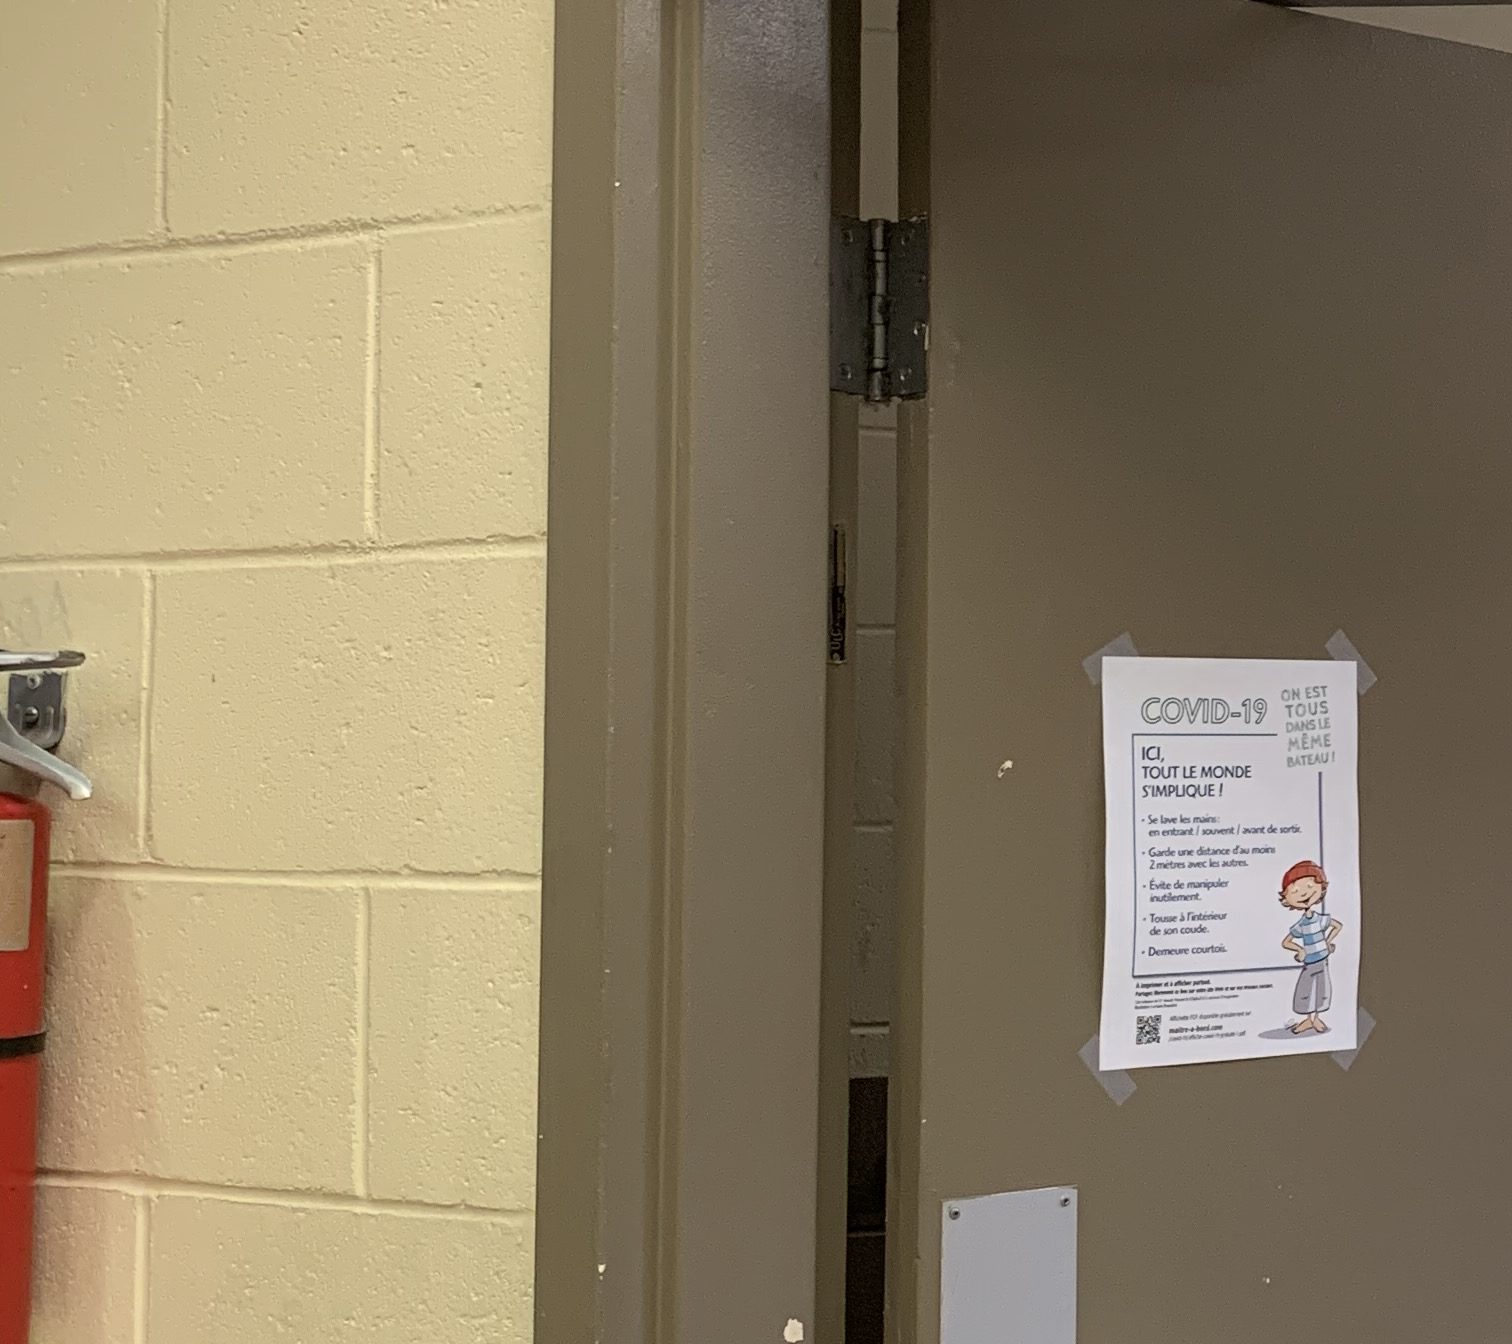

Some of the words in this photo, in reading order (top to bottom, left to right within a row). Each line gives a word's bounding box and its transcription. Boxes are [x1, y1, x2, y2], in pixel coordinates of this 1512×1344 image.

[1281, 687, 1301, 702] ON
[1305, 685, 1328, 699] EST
[1141, 697, 1268, 724] COVID-19
[1285, 700, 1329, 718] TOUS
[1285, 719, 1316, 733] DANS
[1318, 717, 1331, 730] LE
[1287, 732, 1332, 752] MÊME
[1141, 746, 1165, 762] ICI,
[1286, 751, 1329, 768] BATEAU
[1141, 765, 1179, 779] TOUT
[1182, 766, 1197, 779] LE
[1200, 765, 1252, 779] MONDE
[1142, 784, 1215, 798] S'IMPLIQUE
[1147, 814, 1159, 825] Se
[1160, 814, 1178, 824] lave
[1179, 813, 1191, 824] les
[1148, 829, 1160, 837] en
[1161, 827, 1194, 836] entrant
[1202, 826, 1235, 836] souvent
[1242, 825, 1266, 835] avant
[1267, 823, 1278, 834] de
[1148, 846, 1176, 858] Garde
[1177, 848, 1194, 857] une
[1196, 845, 1231, 856] distance
[1232, 845, 1250, 855] d'au
[1251, 843, 1276, 854] moins
[1149, 859, 1155, 870] 2
[1187, 860, 1207, 869] avec
[1209, 857, 1220, 868] les
[1149, 877, 1172, 890] Évite
[1173, 879, 1185, 890] de
[1187, 878, 1229, 891] manipuler
[1149, 913, 1178, 923] Tousse
[1149, 925, 1161, 936] de
[1163, 927, 1178, 935] son
[1180, 924, 1210, 934] coude.
[1148, 946, 1190, 957] Demeure
